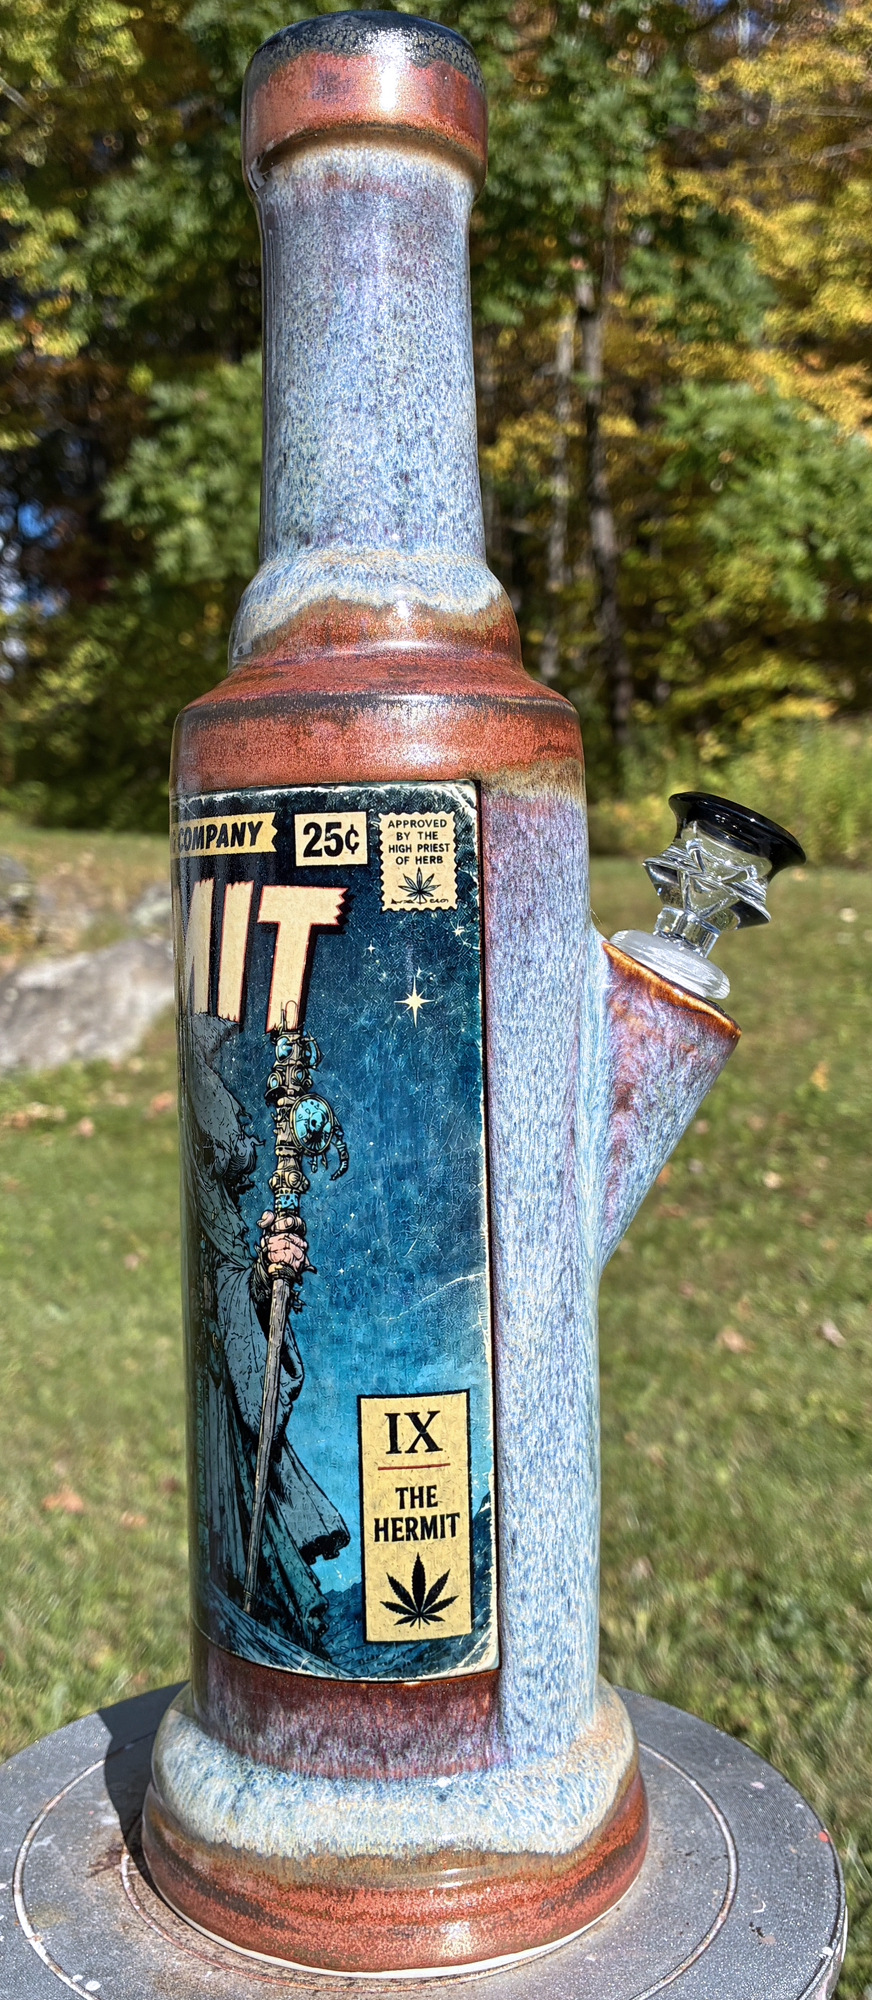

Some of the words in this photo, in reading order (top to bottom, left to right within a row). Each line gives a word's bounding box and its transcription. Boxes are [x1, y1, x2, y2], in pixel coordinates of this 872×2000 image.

[177, 820, 263, 853] COMPANY
[387, 819, 447, 829] APPROVED
[396, 831, 411, 841] BY
[417, 831, 439, 840] THE
[303, 821, 359, 858] 25¢
[388, 844, 412, 853] HIGH
[417, 843, 450, 853] PRIEST
[395, 856, 410, 865] OF
[415, 855, 444, 865] HERB
[384, 1410, 443, 1454] IX
[395, 1485, 438, 1510] THE
[374, 1512, 460, 1542] HERMIT
